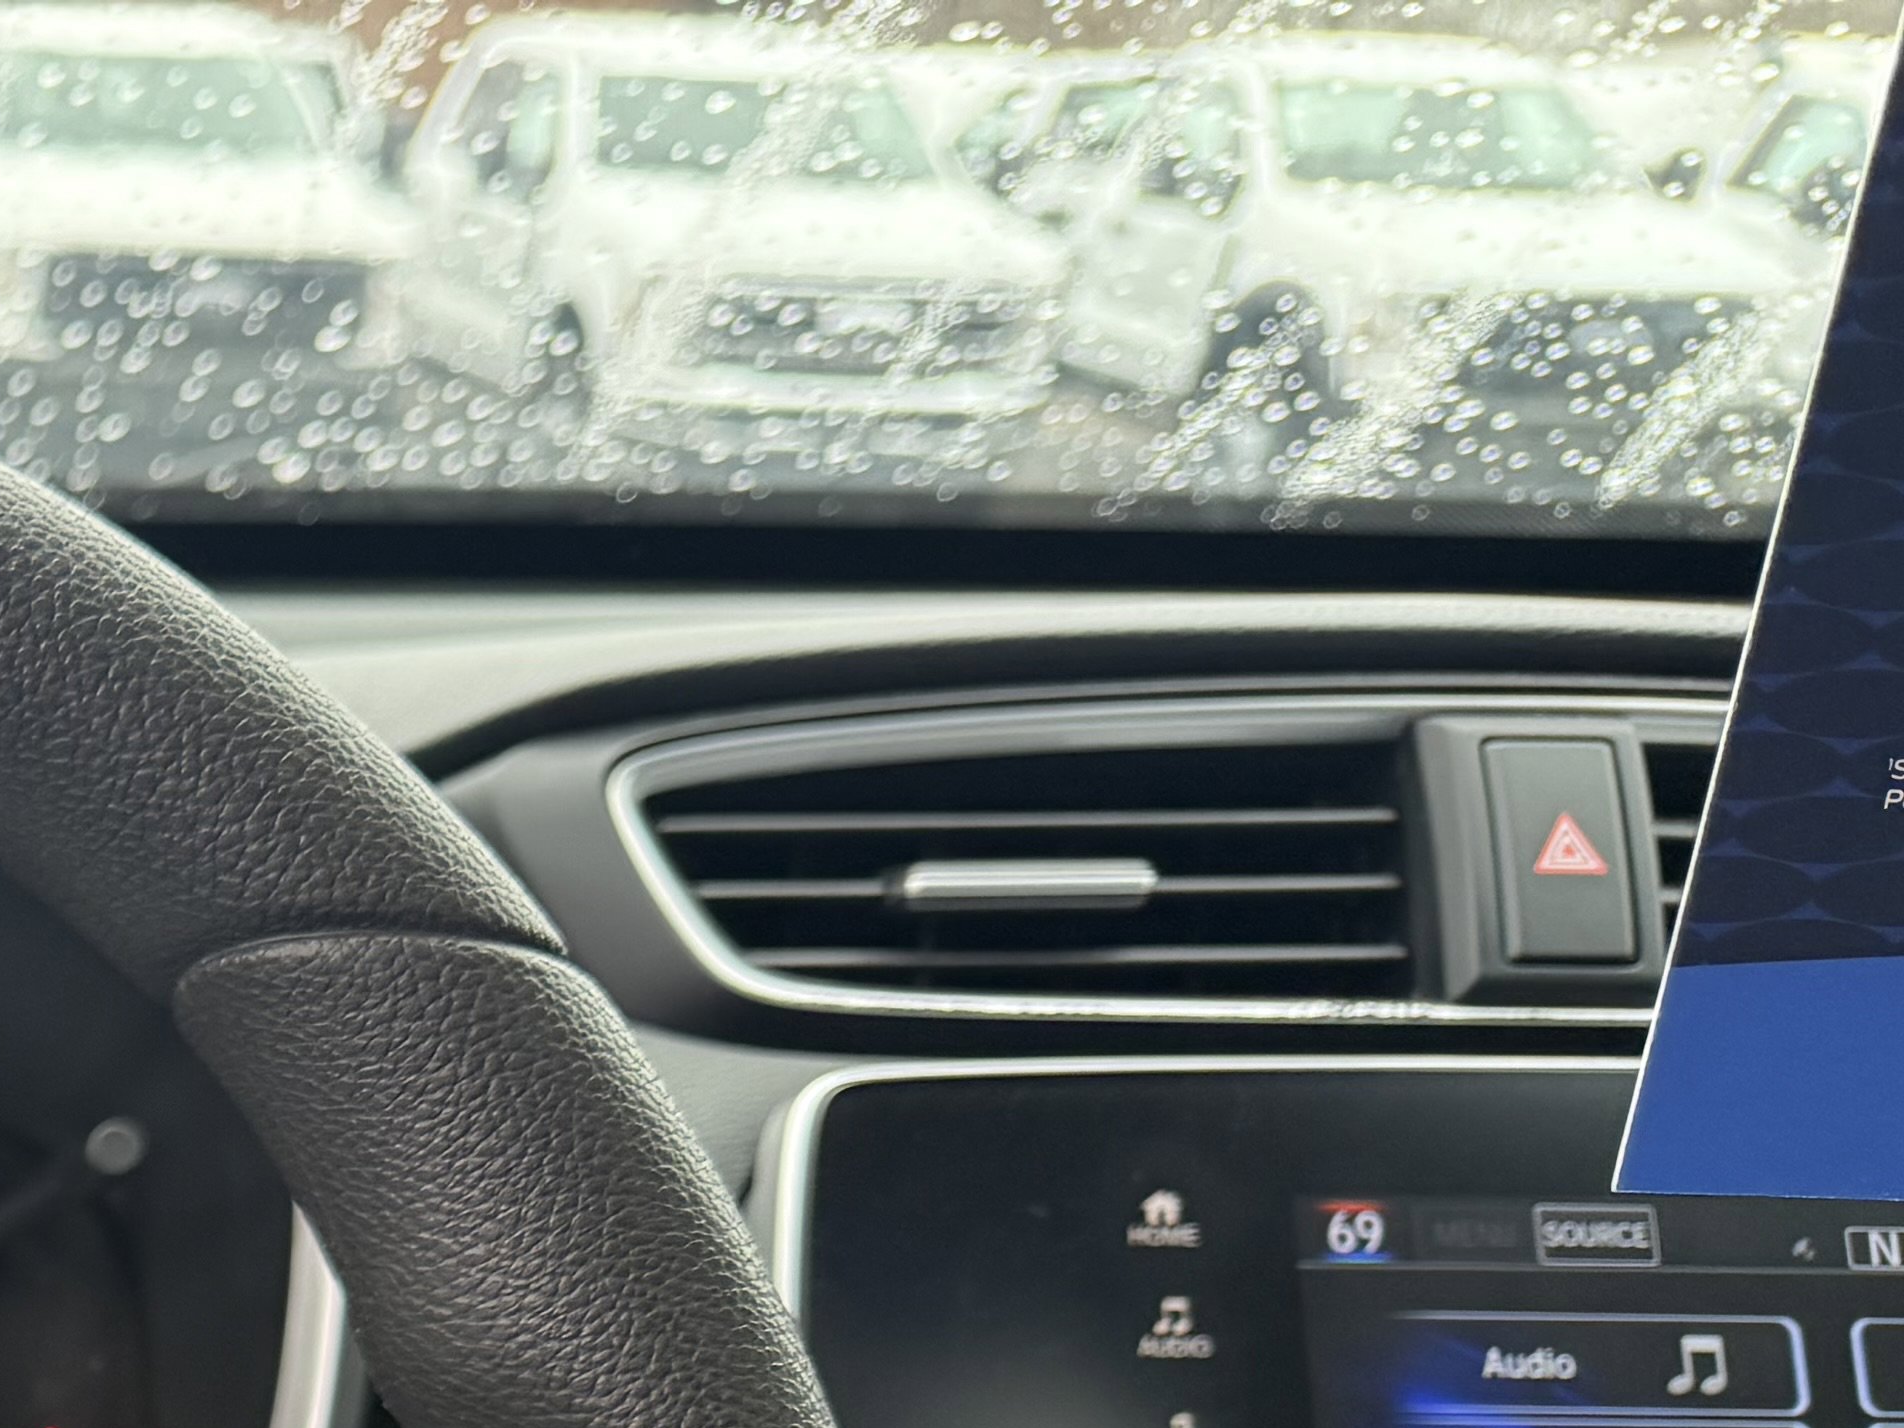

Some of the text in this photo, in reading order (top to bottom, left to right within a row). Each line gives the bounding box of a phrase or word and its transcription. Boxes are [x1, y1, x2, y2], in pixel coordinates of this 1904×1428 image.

[1126, 1222, 1202, 1248] HOME
[1326, 1208, 1385, 1255] 69
[1542, 1219, 1650, 1249] SOURCE
[1481, 1346, 1578, 1381] Audio
